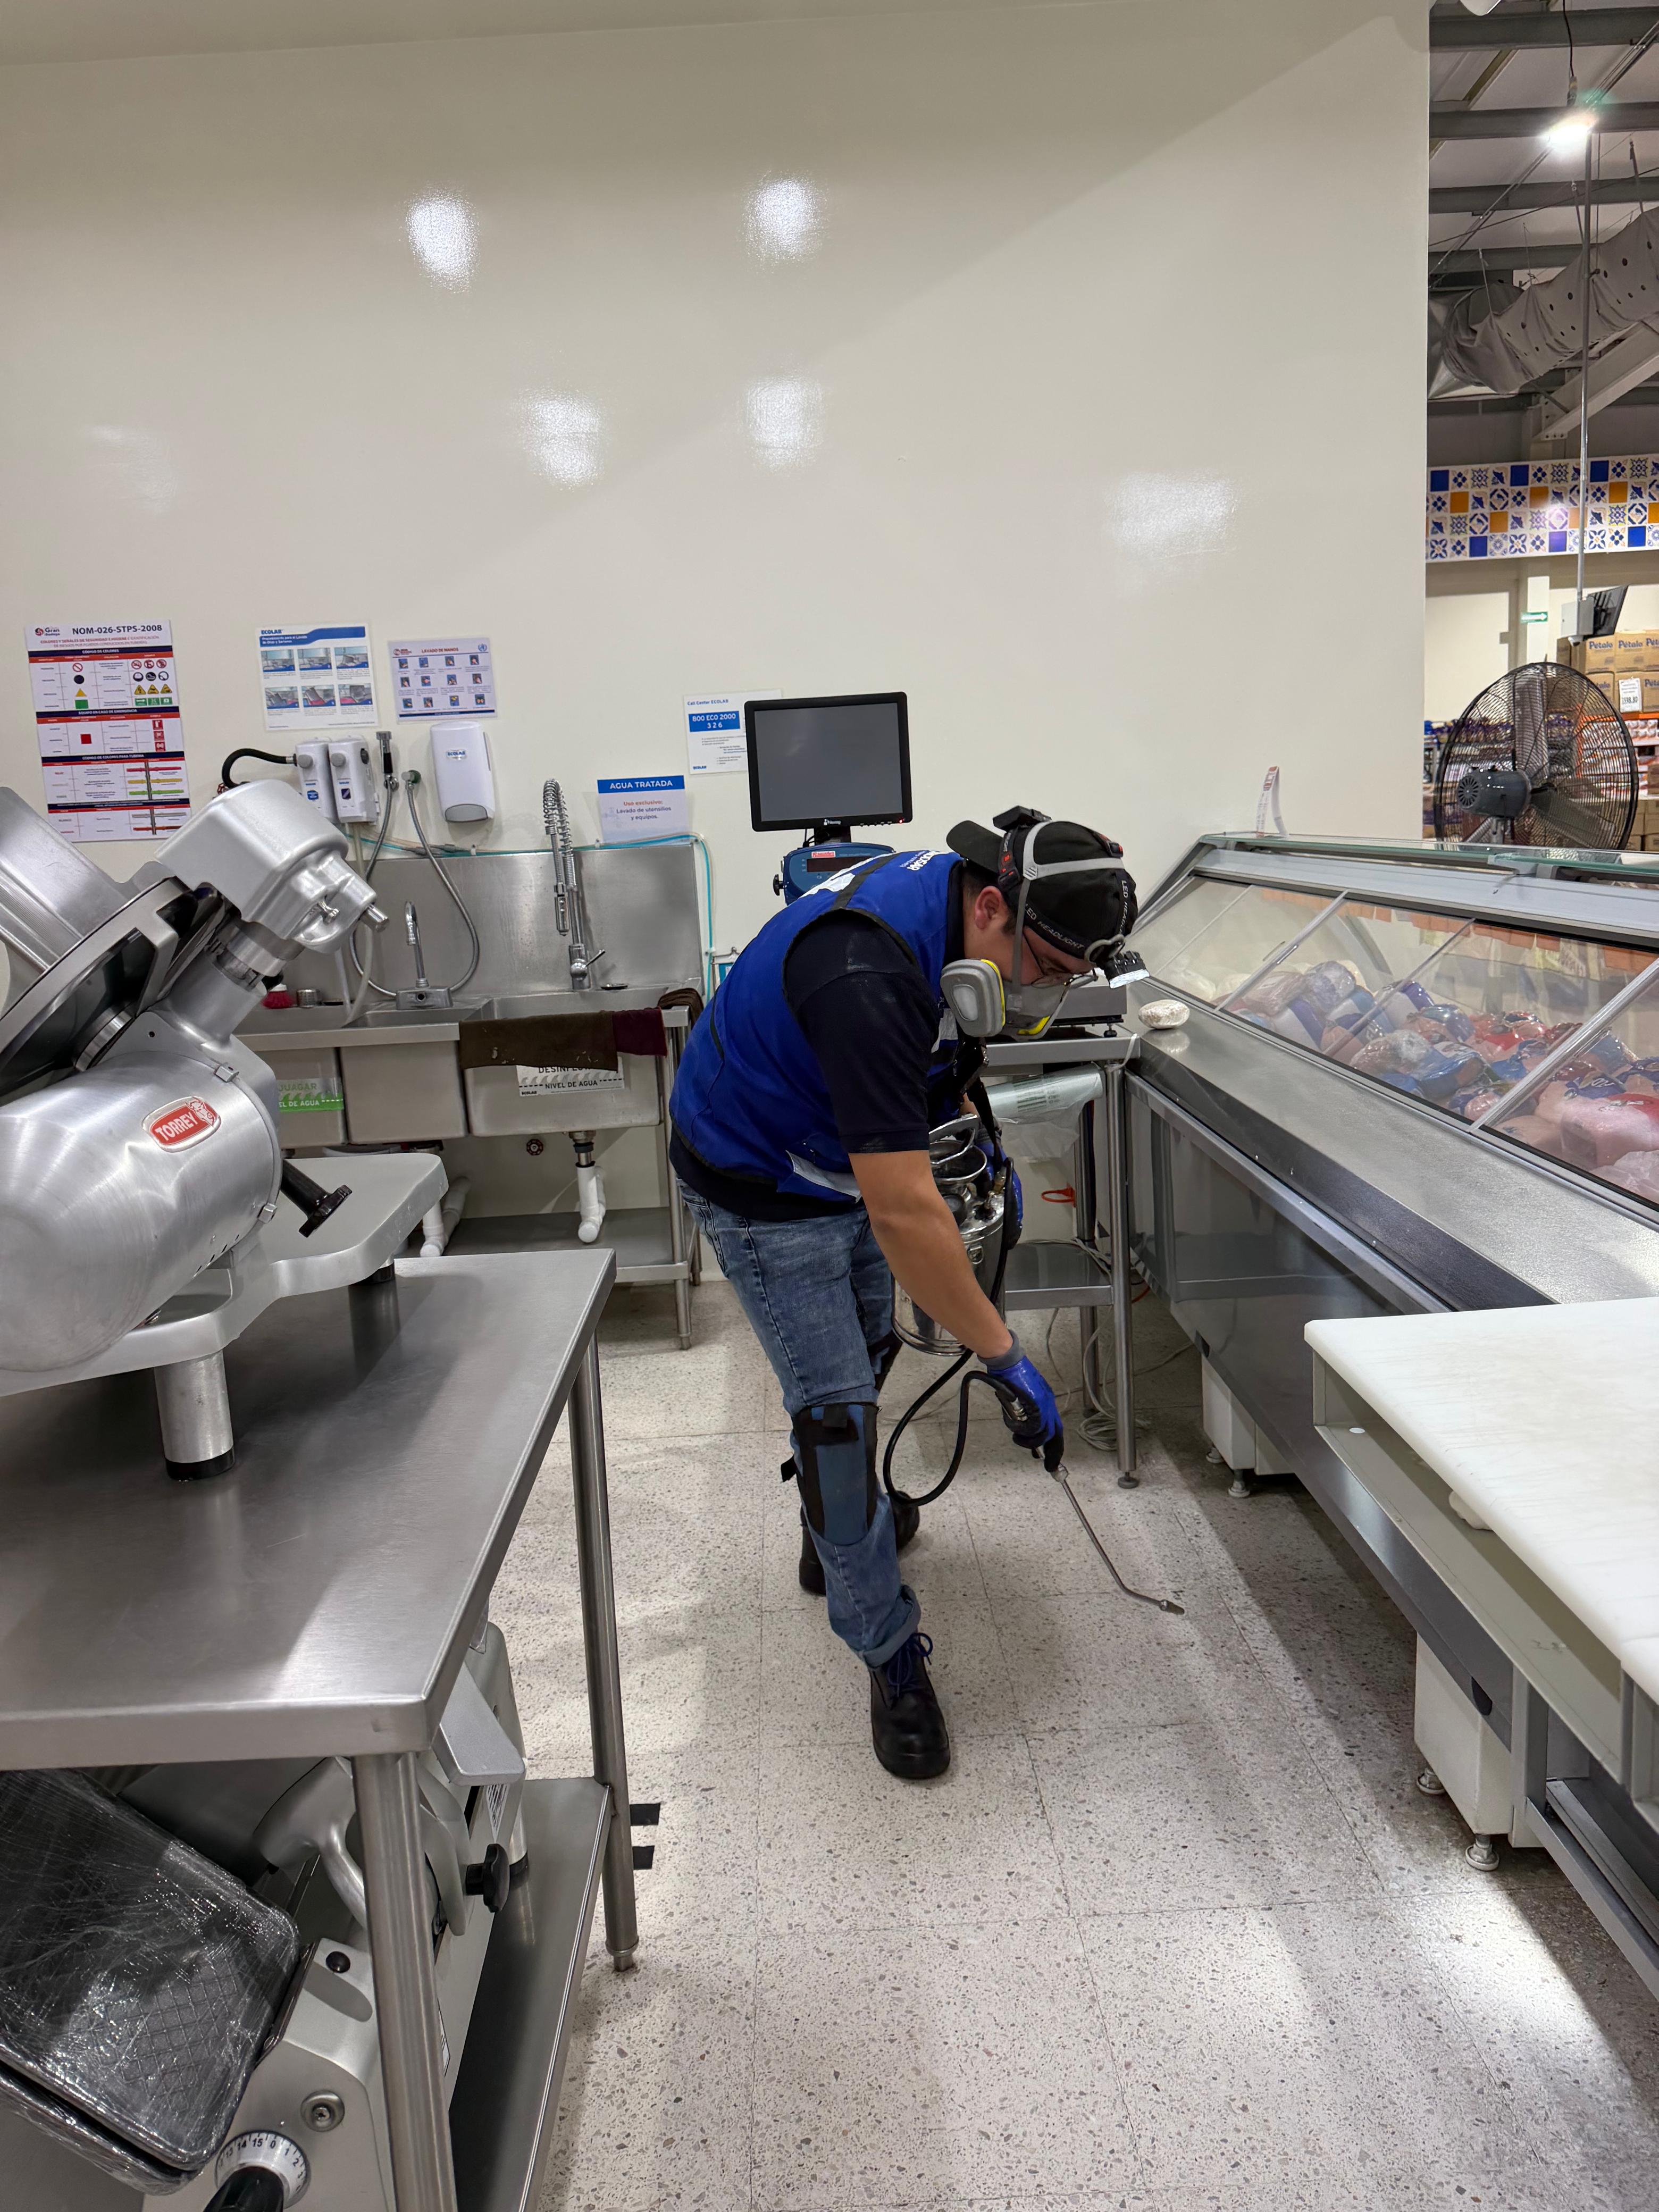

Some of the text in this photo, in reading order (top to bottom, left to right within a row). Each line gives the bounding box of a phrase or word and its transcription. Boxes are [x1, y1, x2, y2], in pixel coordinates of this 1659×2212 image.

[72, 625, 162, 635] NOM-026-STPS-2008
[155, 1111, 198, 1141] TORREY
[238, 2140, 247, 2151] 14
[252, 2138, 263, 2147] 15
[270, 2140, 276, 2149] 0
[293, 2158, 299, 2167] 2
